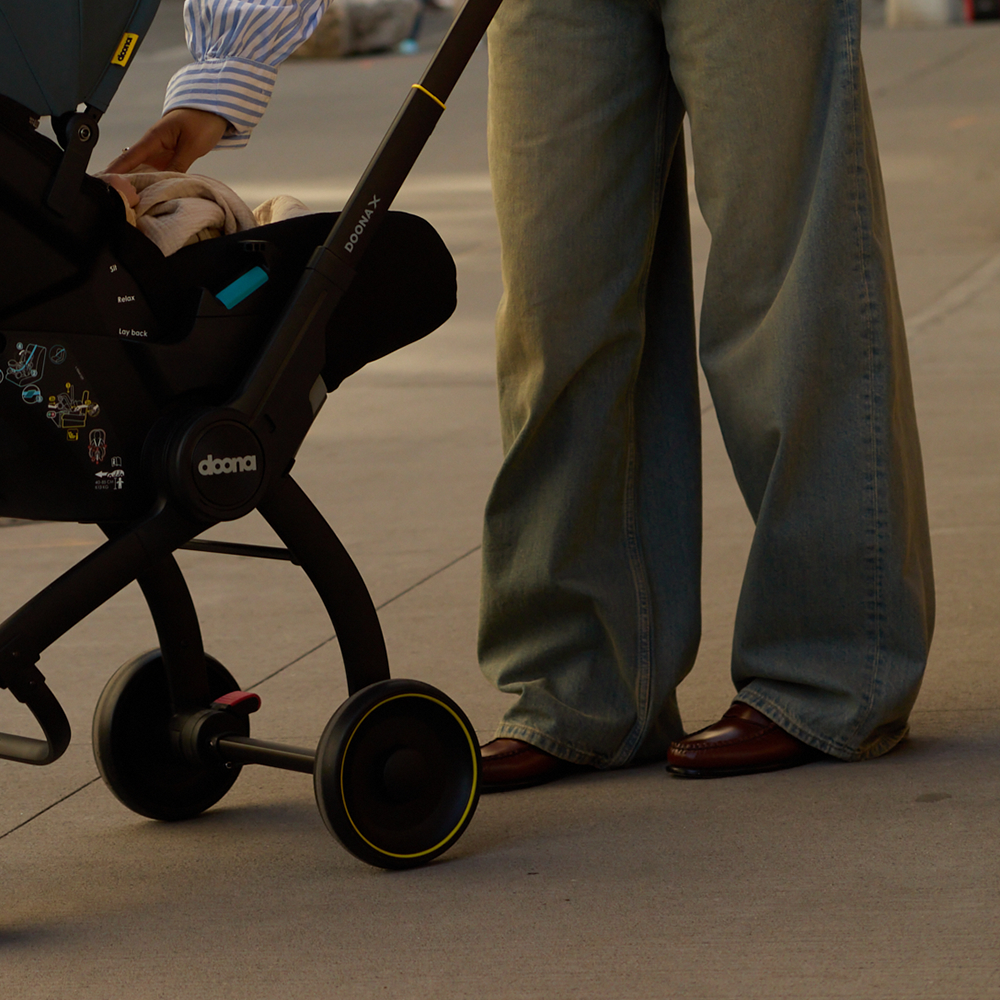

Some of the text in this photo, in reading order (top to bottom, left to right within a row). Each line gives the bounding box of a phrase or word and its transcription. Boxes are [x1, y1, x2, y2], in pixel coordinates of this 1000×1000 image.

[117, 37, 133, 61] doona
[344, 194, 381, 253] DOONA X
[117, 295, 135, 303] Relax
[118, 327, 148, 338] Lay back
[198, 454, 257, 476] doona
